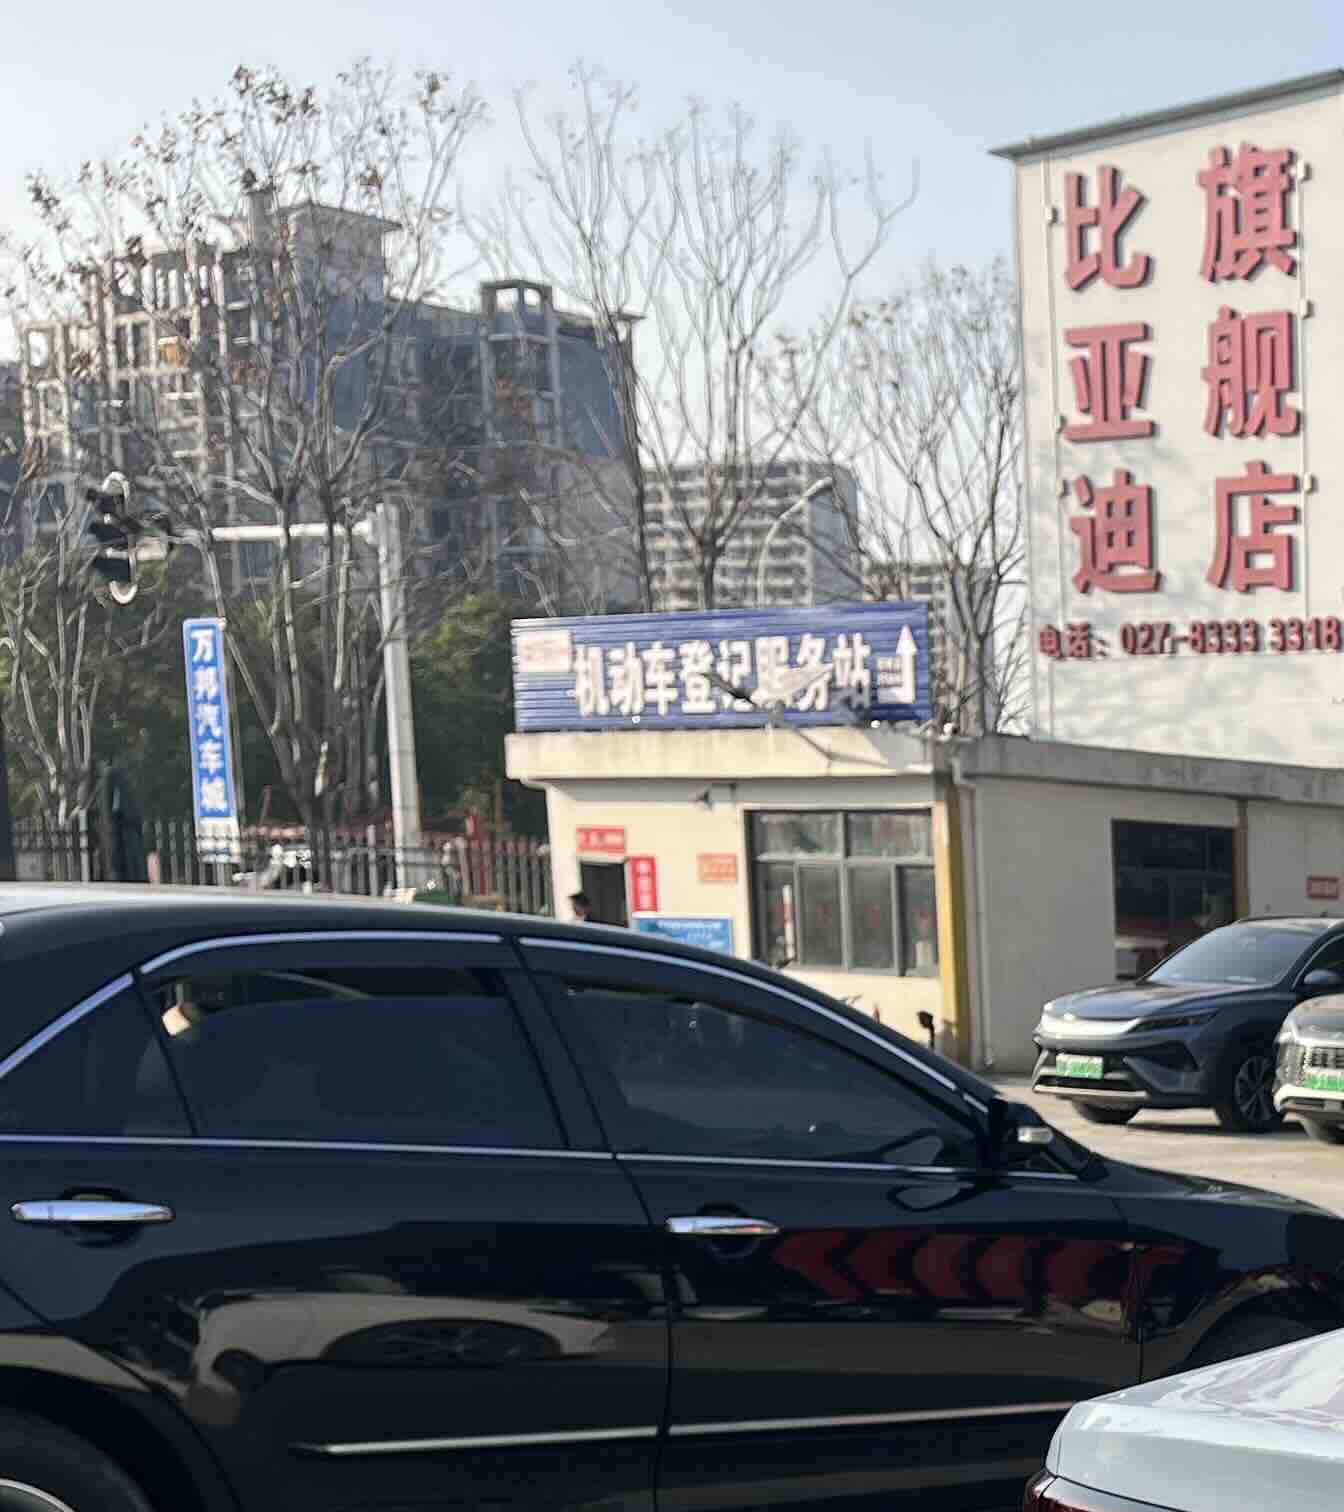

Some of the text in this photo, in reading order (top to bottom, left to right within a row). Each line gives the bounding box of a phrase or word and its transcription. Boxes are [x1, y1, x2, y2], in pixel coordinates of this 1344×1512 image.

[1061, 164, 1161, 597] 比亚迪
[1195, 142, 1303, 595] 旗舰店
[573, 631, 873, 717] 机动车登记服务站
[1269, 615, 1343, 655] 3318
